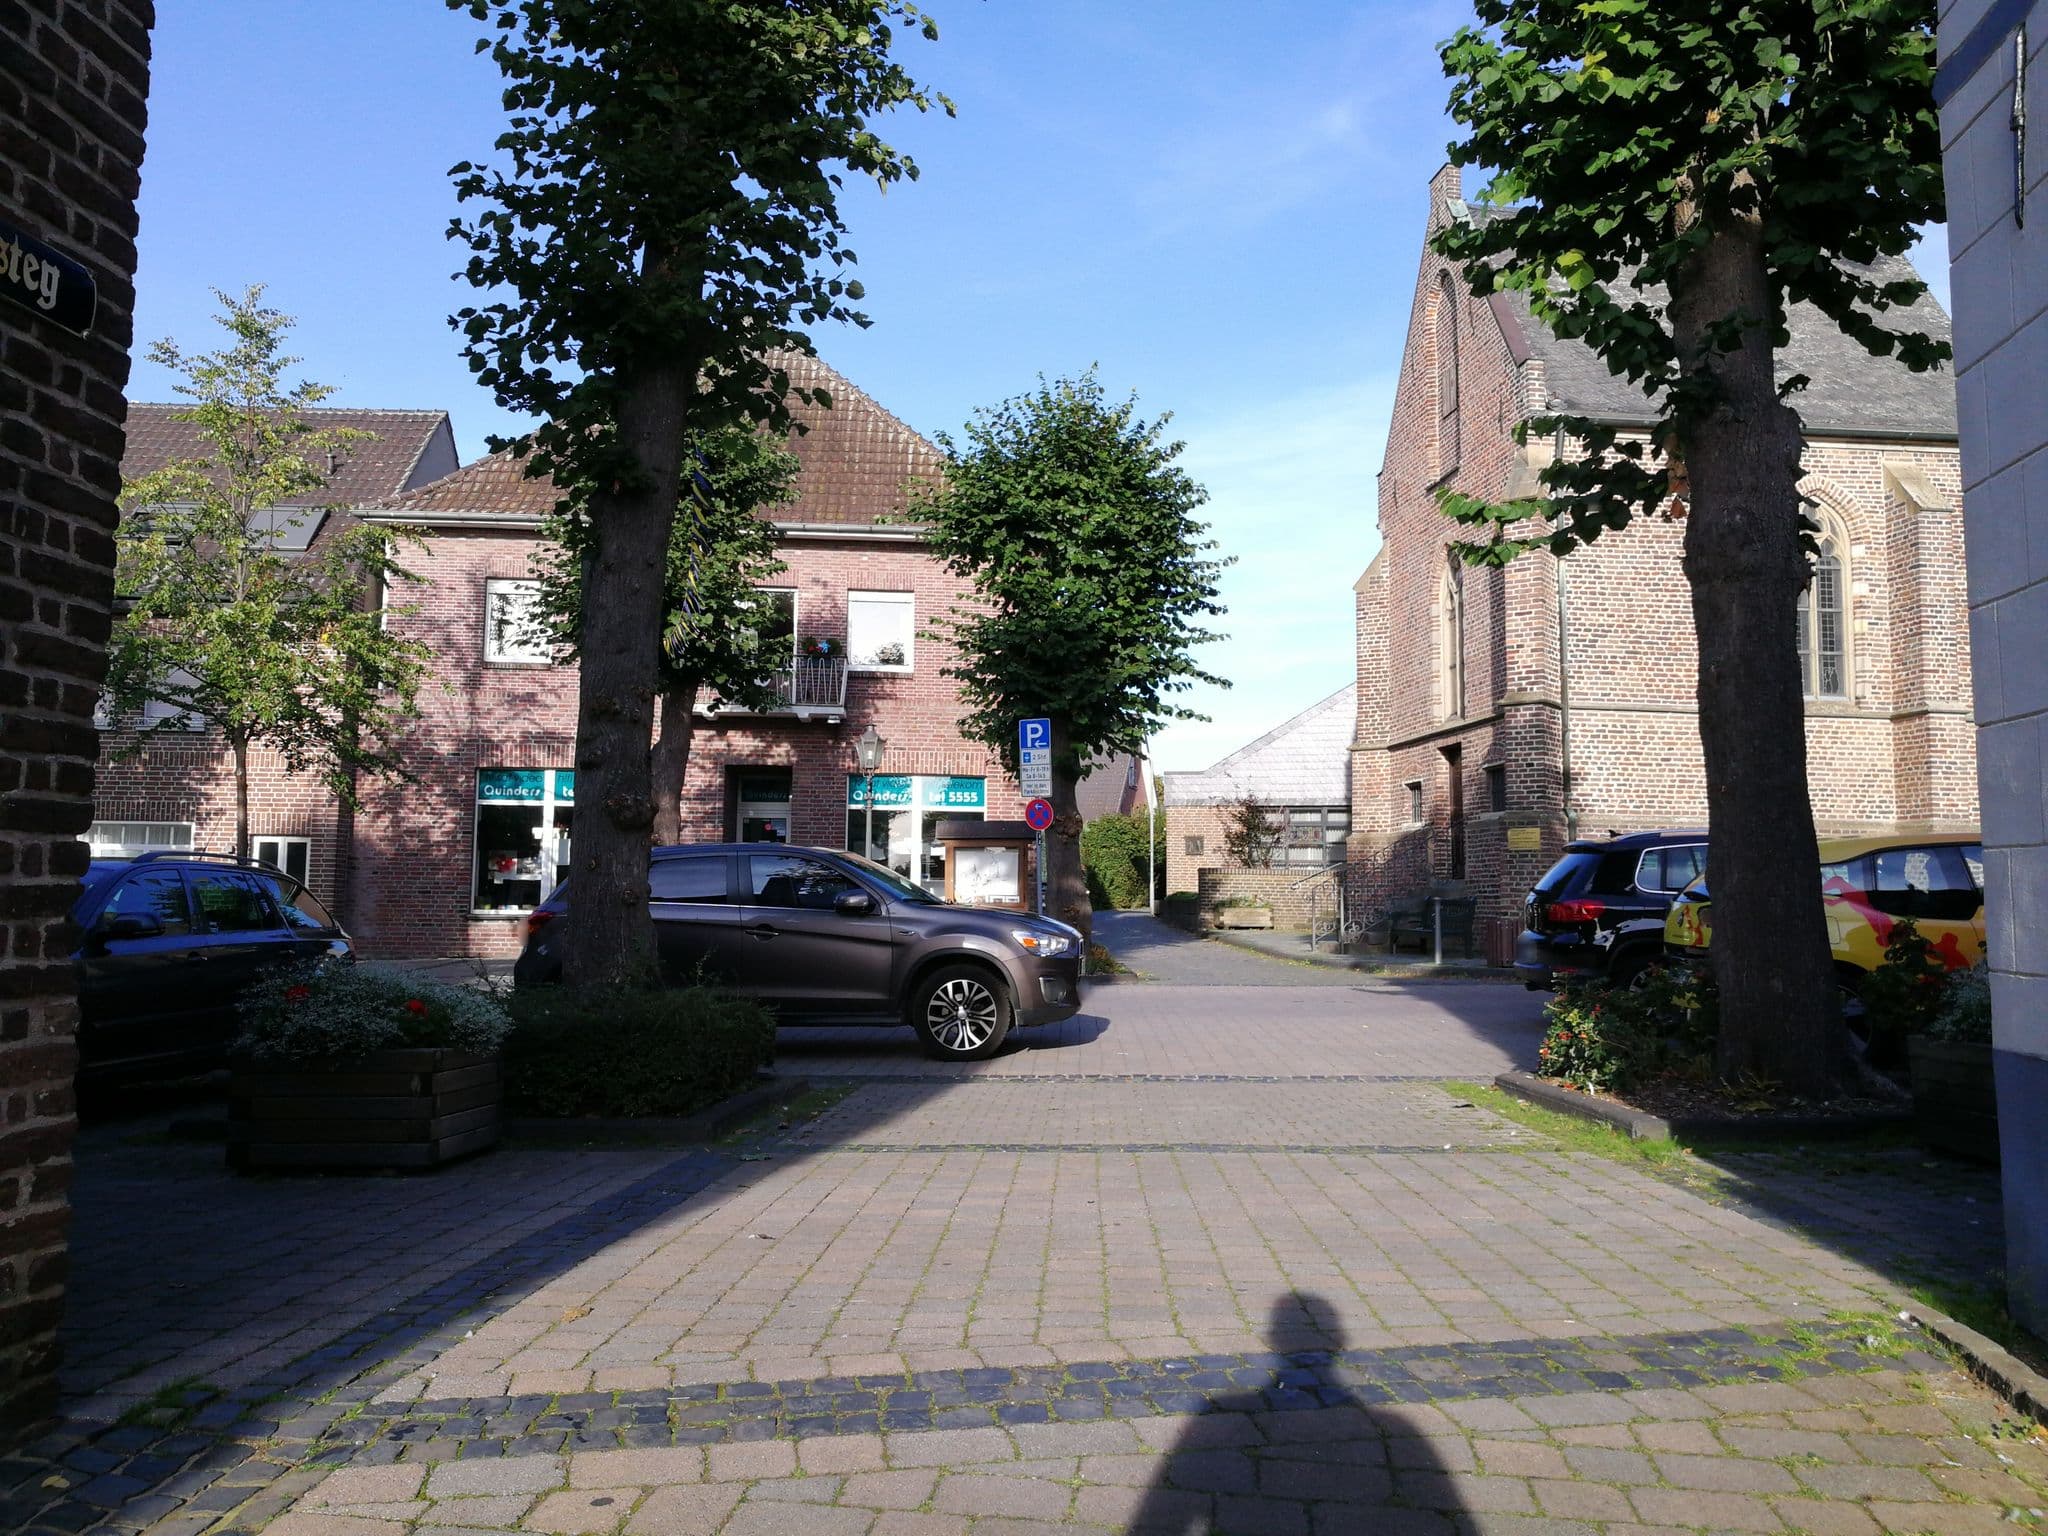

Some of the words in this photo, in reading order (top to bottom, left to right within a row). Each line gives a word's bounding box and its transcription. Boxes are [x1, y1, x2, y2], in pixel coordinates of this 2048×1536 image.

[1026, 723, 1043, 748] P
[484, 784, 541, 797] Quinders
[948, 791, 979, 803] 5555
